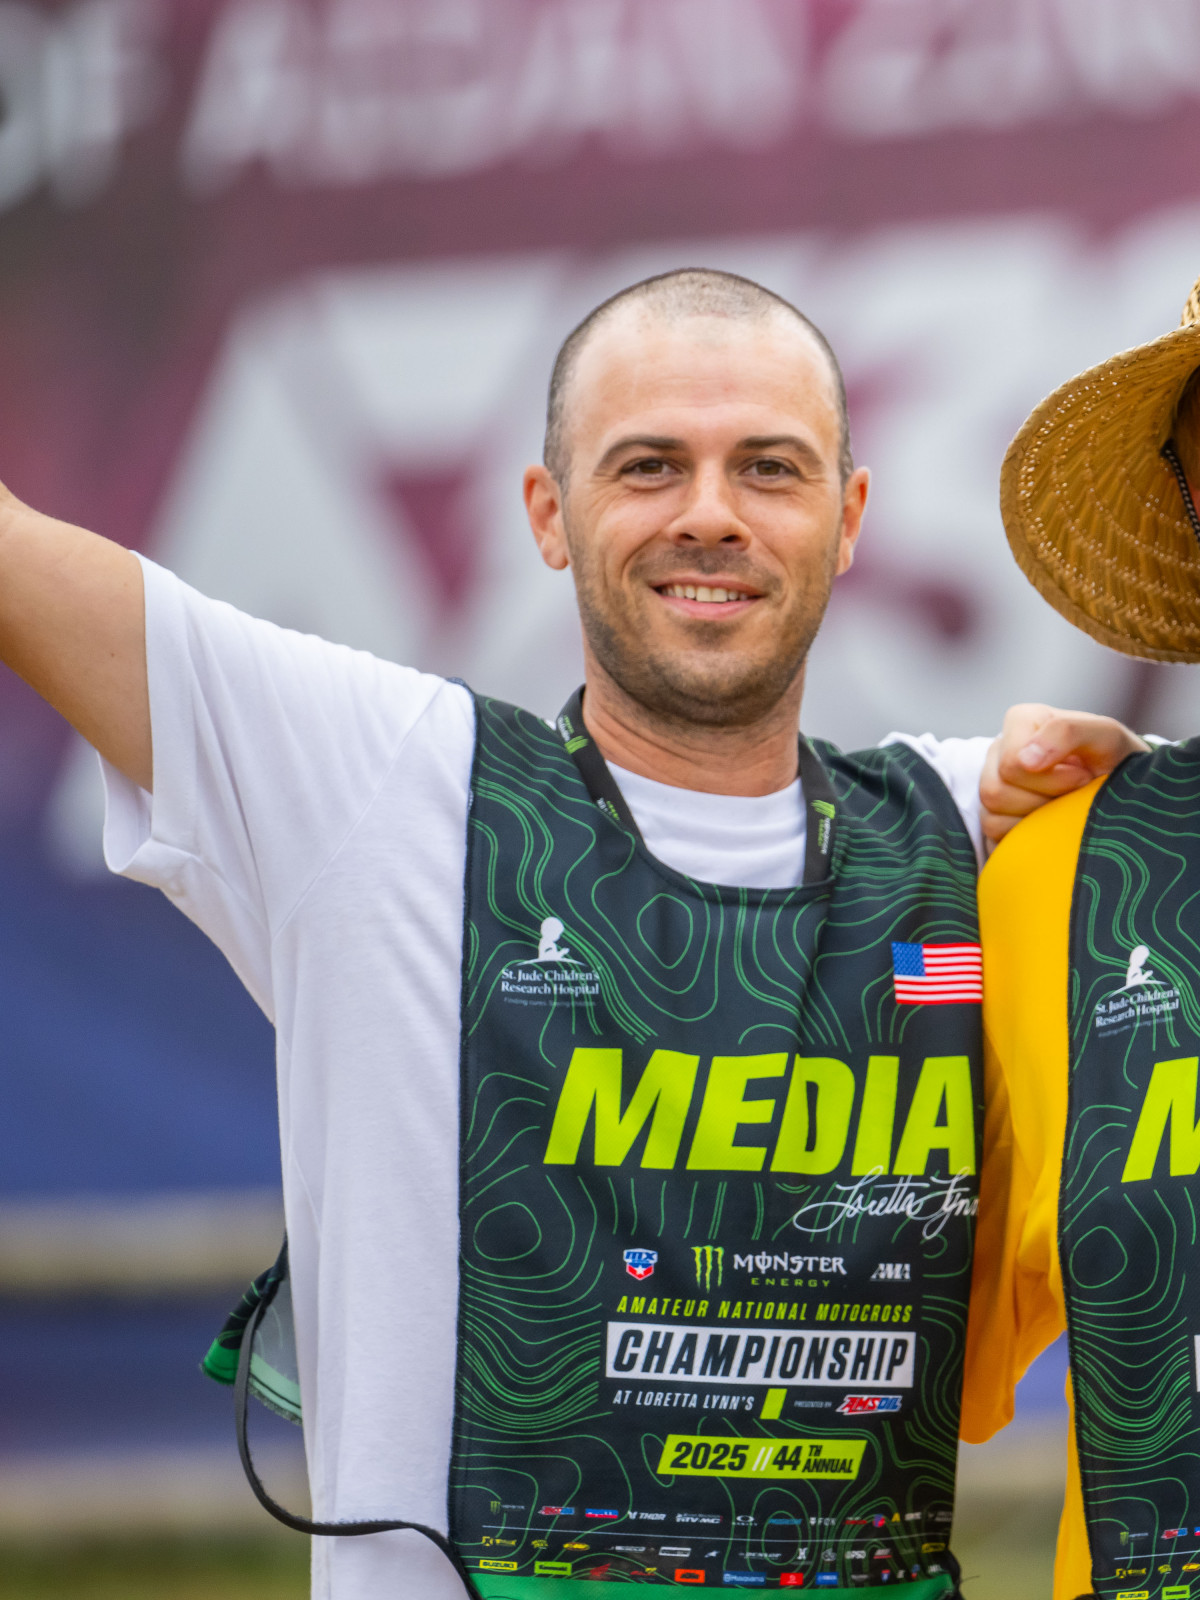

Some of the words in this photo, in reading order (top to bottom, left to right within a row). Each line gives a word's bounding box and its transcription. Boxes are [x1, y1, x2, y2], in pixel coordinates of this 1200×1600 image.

[501, 969, 517, 980] St.
[517, 969, 543, 983] Jude
[544, 969, 600, 982] Children's
[501, 981, 551, 994] Research
[553, 983, 600, 998] Hospital
[1095, 1003, 1108, 1014] St.
[1109, 998, 1129, 1014] Jude
[1129, 986, 1181, 1004] Children's
[1095, 1008, 1135, 1028] Research
[1136, 998, 1180, 1016] Hospital
[543, 1047, 977, 1176] MEDIA
[793, 1165, 930, 1233] Loretta
[733, 1251, 848, 1276] MONSTER
[870, 1262, 912, 1281] AMA
[751, 1278, 831, 1288] ENERGY
[616, 1295, 709, 1318] AMATEUR
[717, 1300, 807, 1321] NATIONAL
[815, 1303, 913, 1323] MOTOCROSS
[612, 1328, 909, 1382] CHAMPIONSHIP
[613, 1389, 632, 1405] AT
[636, 1390, 698, 1409] LORETTA
[703, 1393, 755, 1411] LYNN'S
[794, 1400, 822, 1408] PRESENTED
[824, 1401, 832, 1409] BY
[839, 1395, 902, 1414] AMSOIL
[670, 1441, 750, 1471] 2025
[772, 1445, 803, 1471] 44
[809, 1445, 823, 1458] TH
[802, 1458, 854, 1474] ANNUAL
[639, 1512, 666, 1520] THOR
